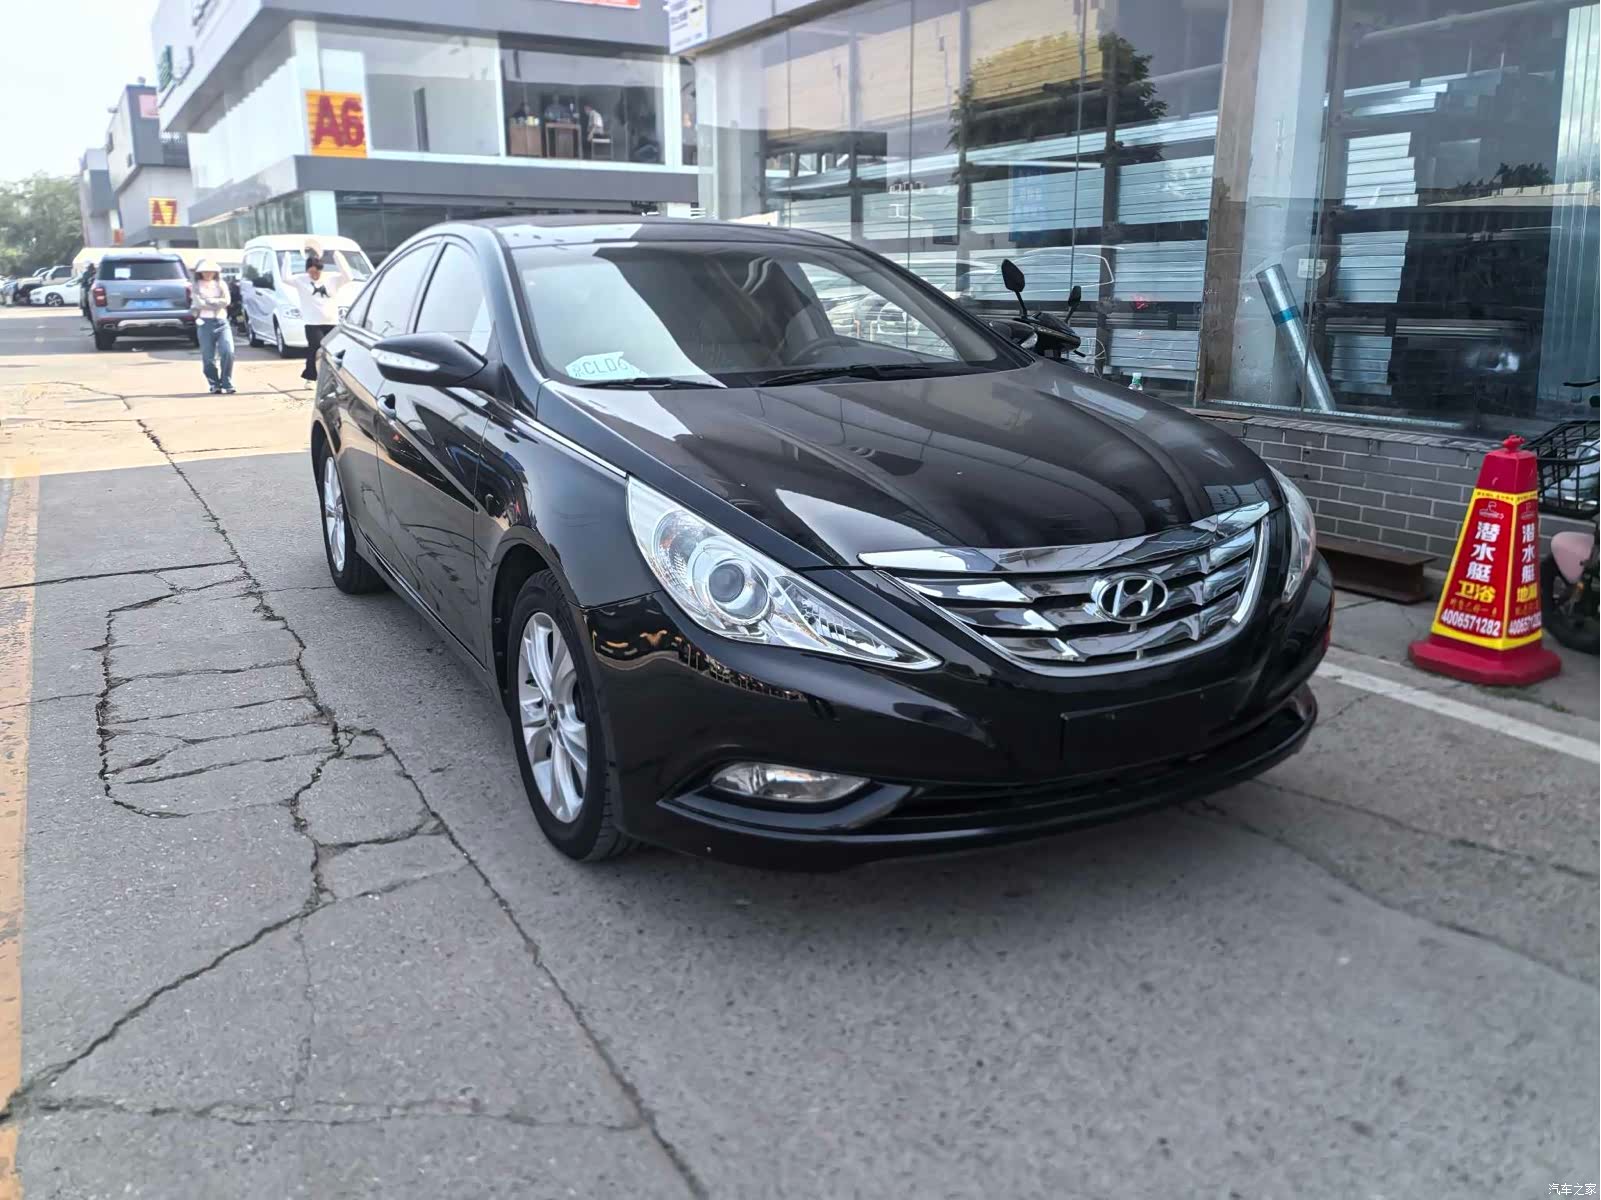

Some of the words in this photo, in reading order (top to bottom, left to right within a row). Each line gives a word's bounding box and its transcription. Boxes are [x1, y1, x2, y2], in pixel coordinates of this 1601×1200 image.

[312, 95, 365, 147] A6
[152, 200, 177, 225] A7
[1466, 521, 1500, 582] 潜水艇
[1455, 580, 1496, 603] 卫浴
[1441, 608, 1501, 637] 4006571282
